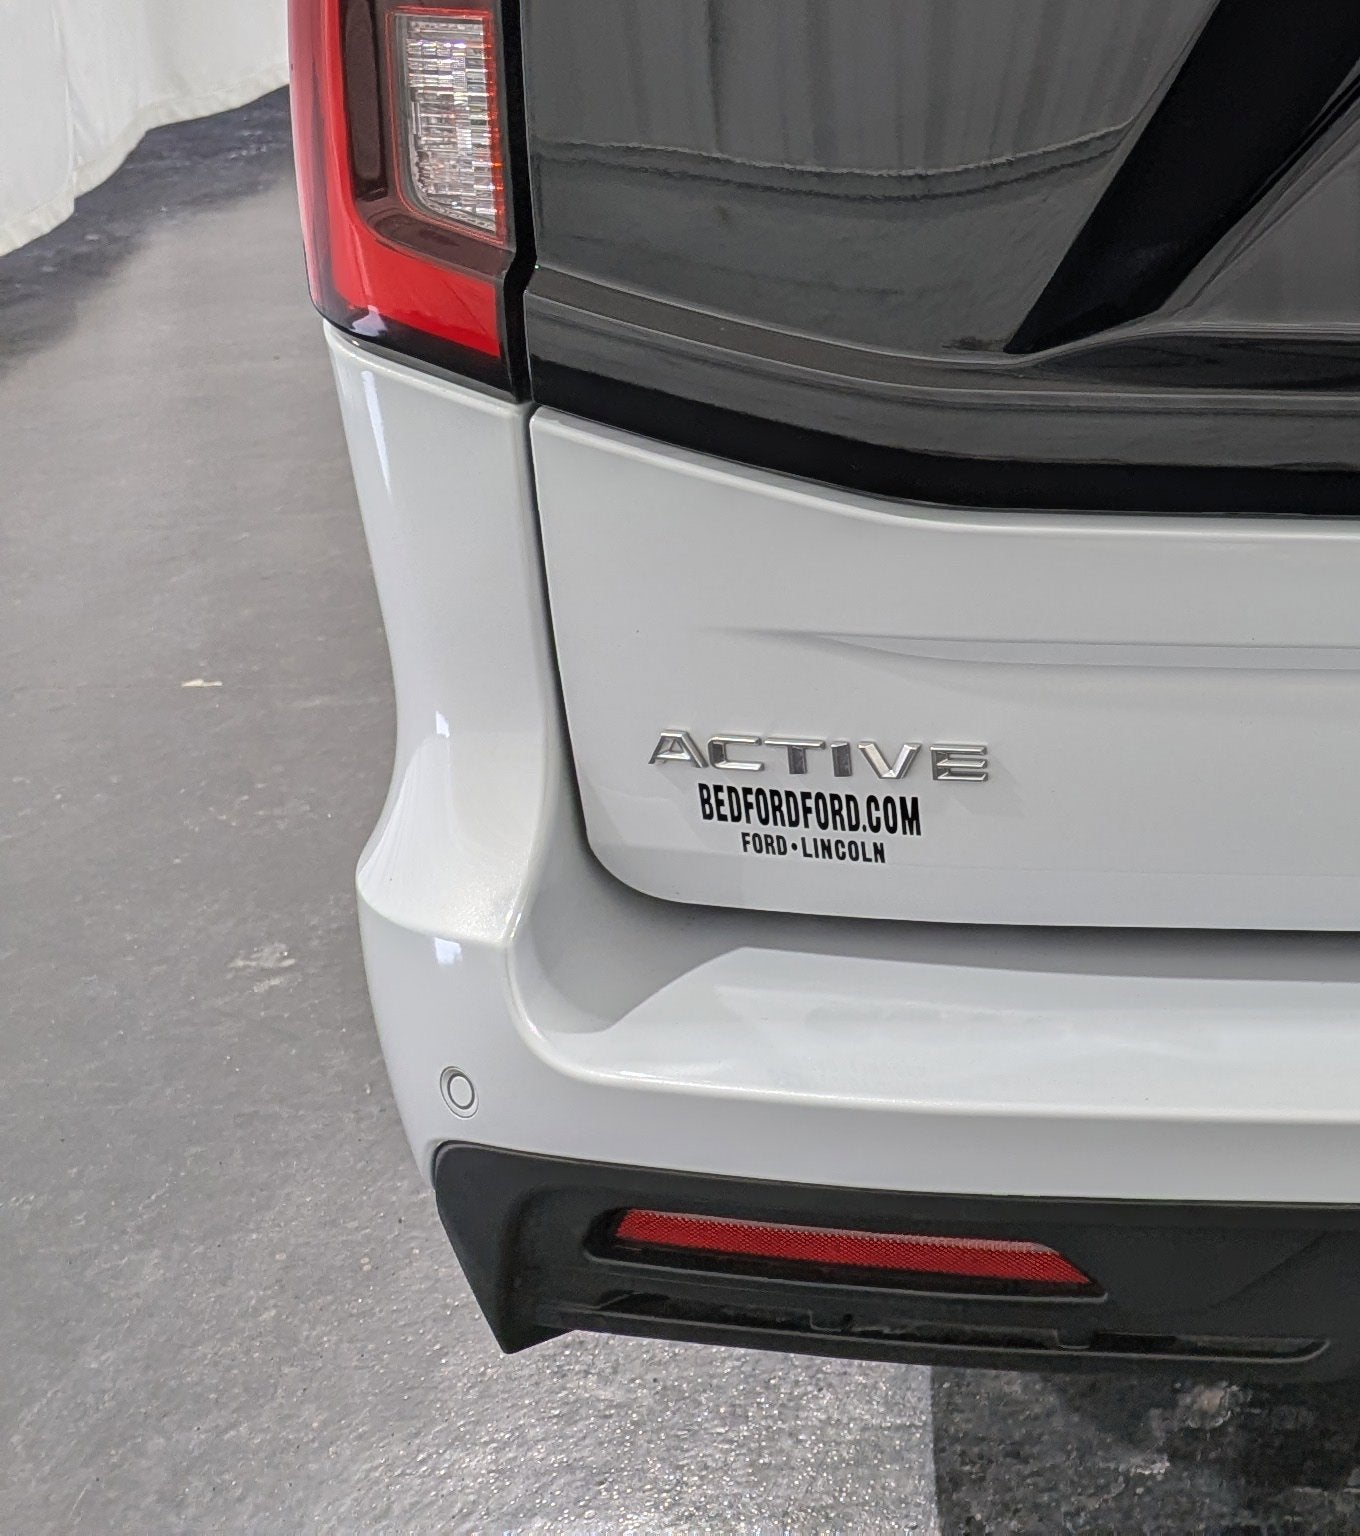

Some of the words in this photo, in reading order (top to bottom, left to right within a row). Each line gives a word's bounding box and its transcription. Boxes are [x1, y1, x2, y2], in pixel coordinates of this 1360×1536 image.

[648, 729, 990, 782] ACTIVE
[698, 782, 922, 836] BEDFORDFORD.COM
[741, 831, 788, 857] FORD
[801, 835, 886, 864] LINCOLN
